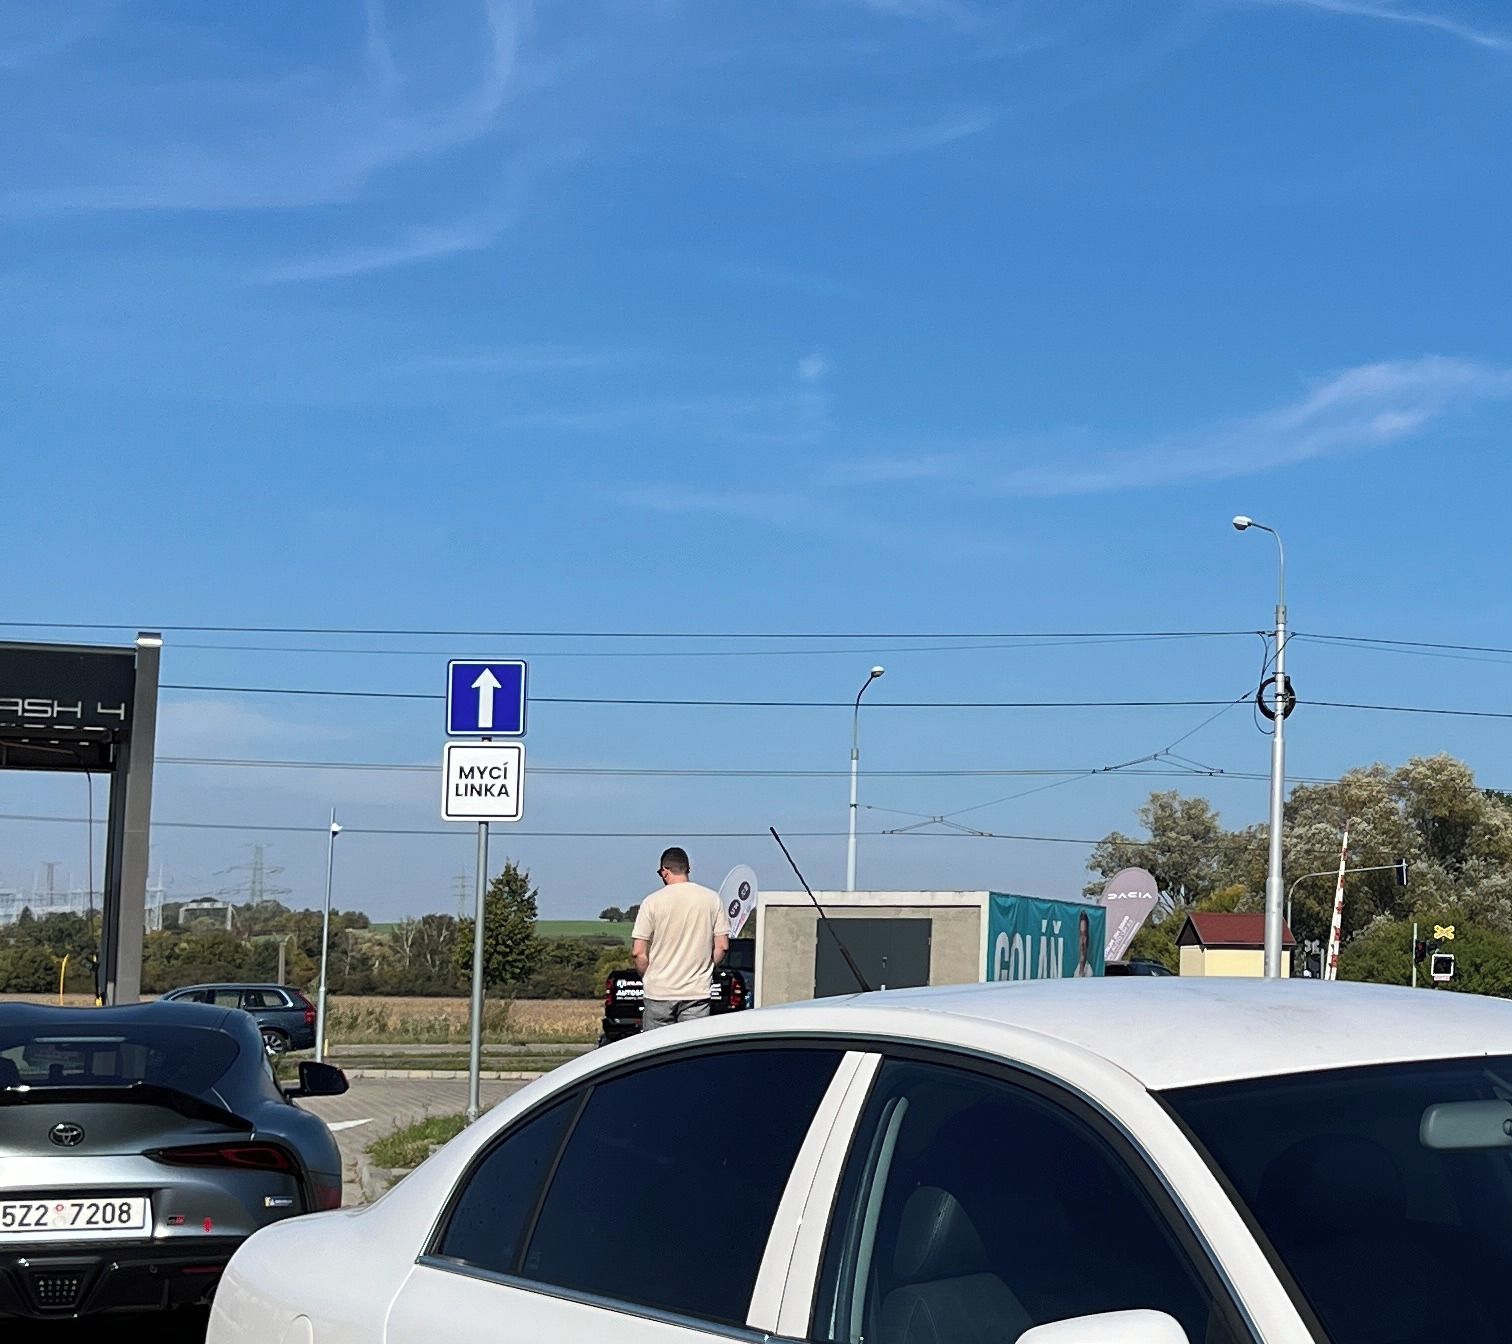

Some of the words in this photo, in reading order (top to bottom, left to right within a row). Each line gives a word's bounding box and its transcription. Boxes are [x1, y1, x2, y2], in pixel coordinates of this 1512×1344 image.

[97, 702, 125, 720] 4
[459, 761, 508, 780] MYCÍ
[455, 783, 510, 797] LINKA
[1107, 891, 1152, 900] DACIA
[1, 1204, 49, 1227] 5Z2
[70, 1202, 132, 1225] 7208
